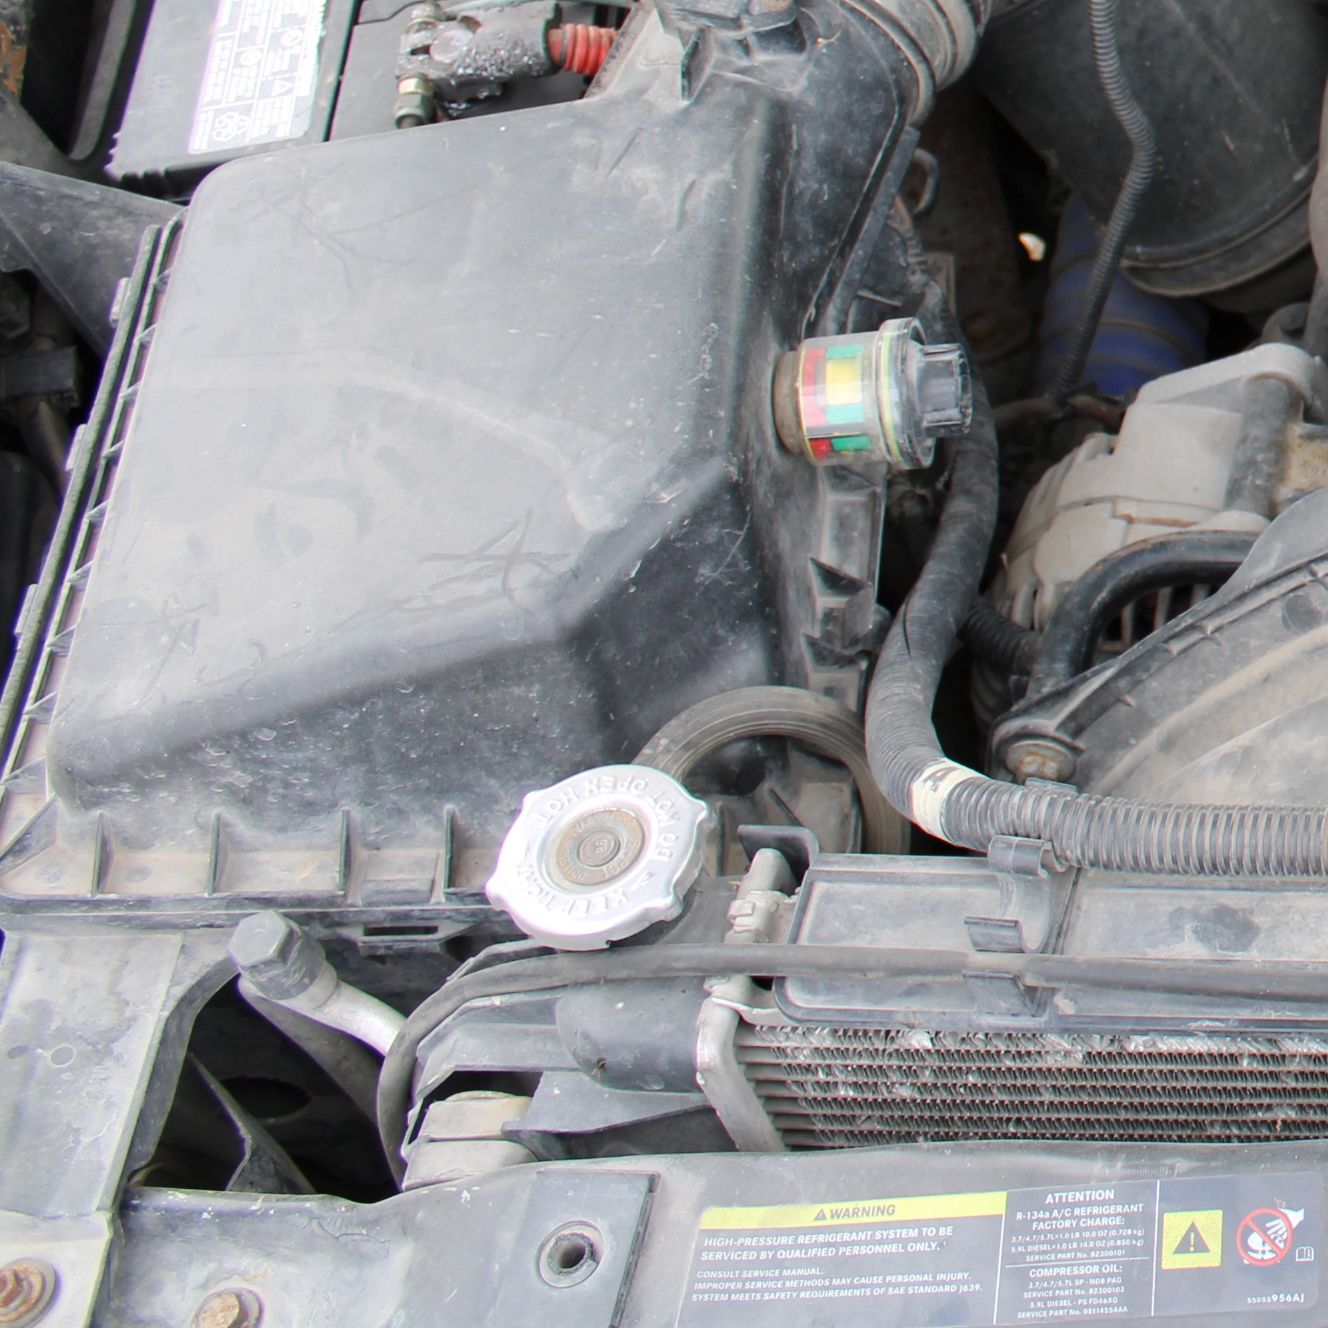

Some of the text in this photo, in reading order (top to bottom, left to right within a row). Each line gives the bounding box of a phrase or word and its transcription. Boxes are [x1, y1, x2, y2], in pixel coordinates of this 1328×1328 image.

[583, 774, 649, 796] OPEN
[1044, 1189, 1115, 1205] ATTENTION
[829, 1203, 897, 1220] WARNING
[1015, 1203, 1145, 1221] R-134a A/C REFRIGERANT
[1032, 1215, 1125, 1232] FACTORY CHARGE:
[703, 1225, 954, 1248] HIGH-PRESSURE REFRIGERANT SYSTEM TO BE
[701, 1241, 941, 1261] SERVICED BY QUALIFIED PERSONNEL ONLY.
[1068, 1241, 1078, 1249] LB
[1025, 1253, 1056, 1262] SERVICE
[1057, 1252, 1075, 1260] PART
[1076, 1251, 1089, 1259] No.
[696, 1267, 824, 1279] CONSULT SERVICE MANUAL.
[1029, 1264, 1123, 1278] COMPRESSOR OIL:
[694, 1272, 973, 1291] IMPROPER SERVICE METHODS MAY CAUSE PERSONAL INJURY.
[1074, 1278, 1084, 1286] SP
[692, 1283, 983, 1302] SYSTEM MEETS SAFETY REQUIREMENTS OF SAE STANDARD J639.
[1023, 1291, 1054, 1299] SERVICE
[1055, 1289, 1074, 1297] PART
[1074, 1288, 1087, 1296] No.
[1046, 1299, 1072, 1307] DIESEL
[1077, 1298, 1088, 1306] PS
[1017, 1310, 1047, 1319] SERVICE
[1049, 1309, 1068, 1317] PART
